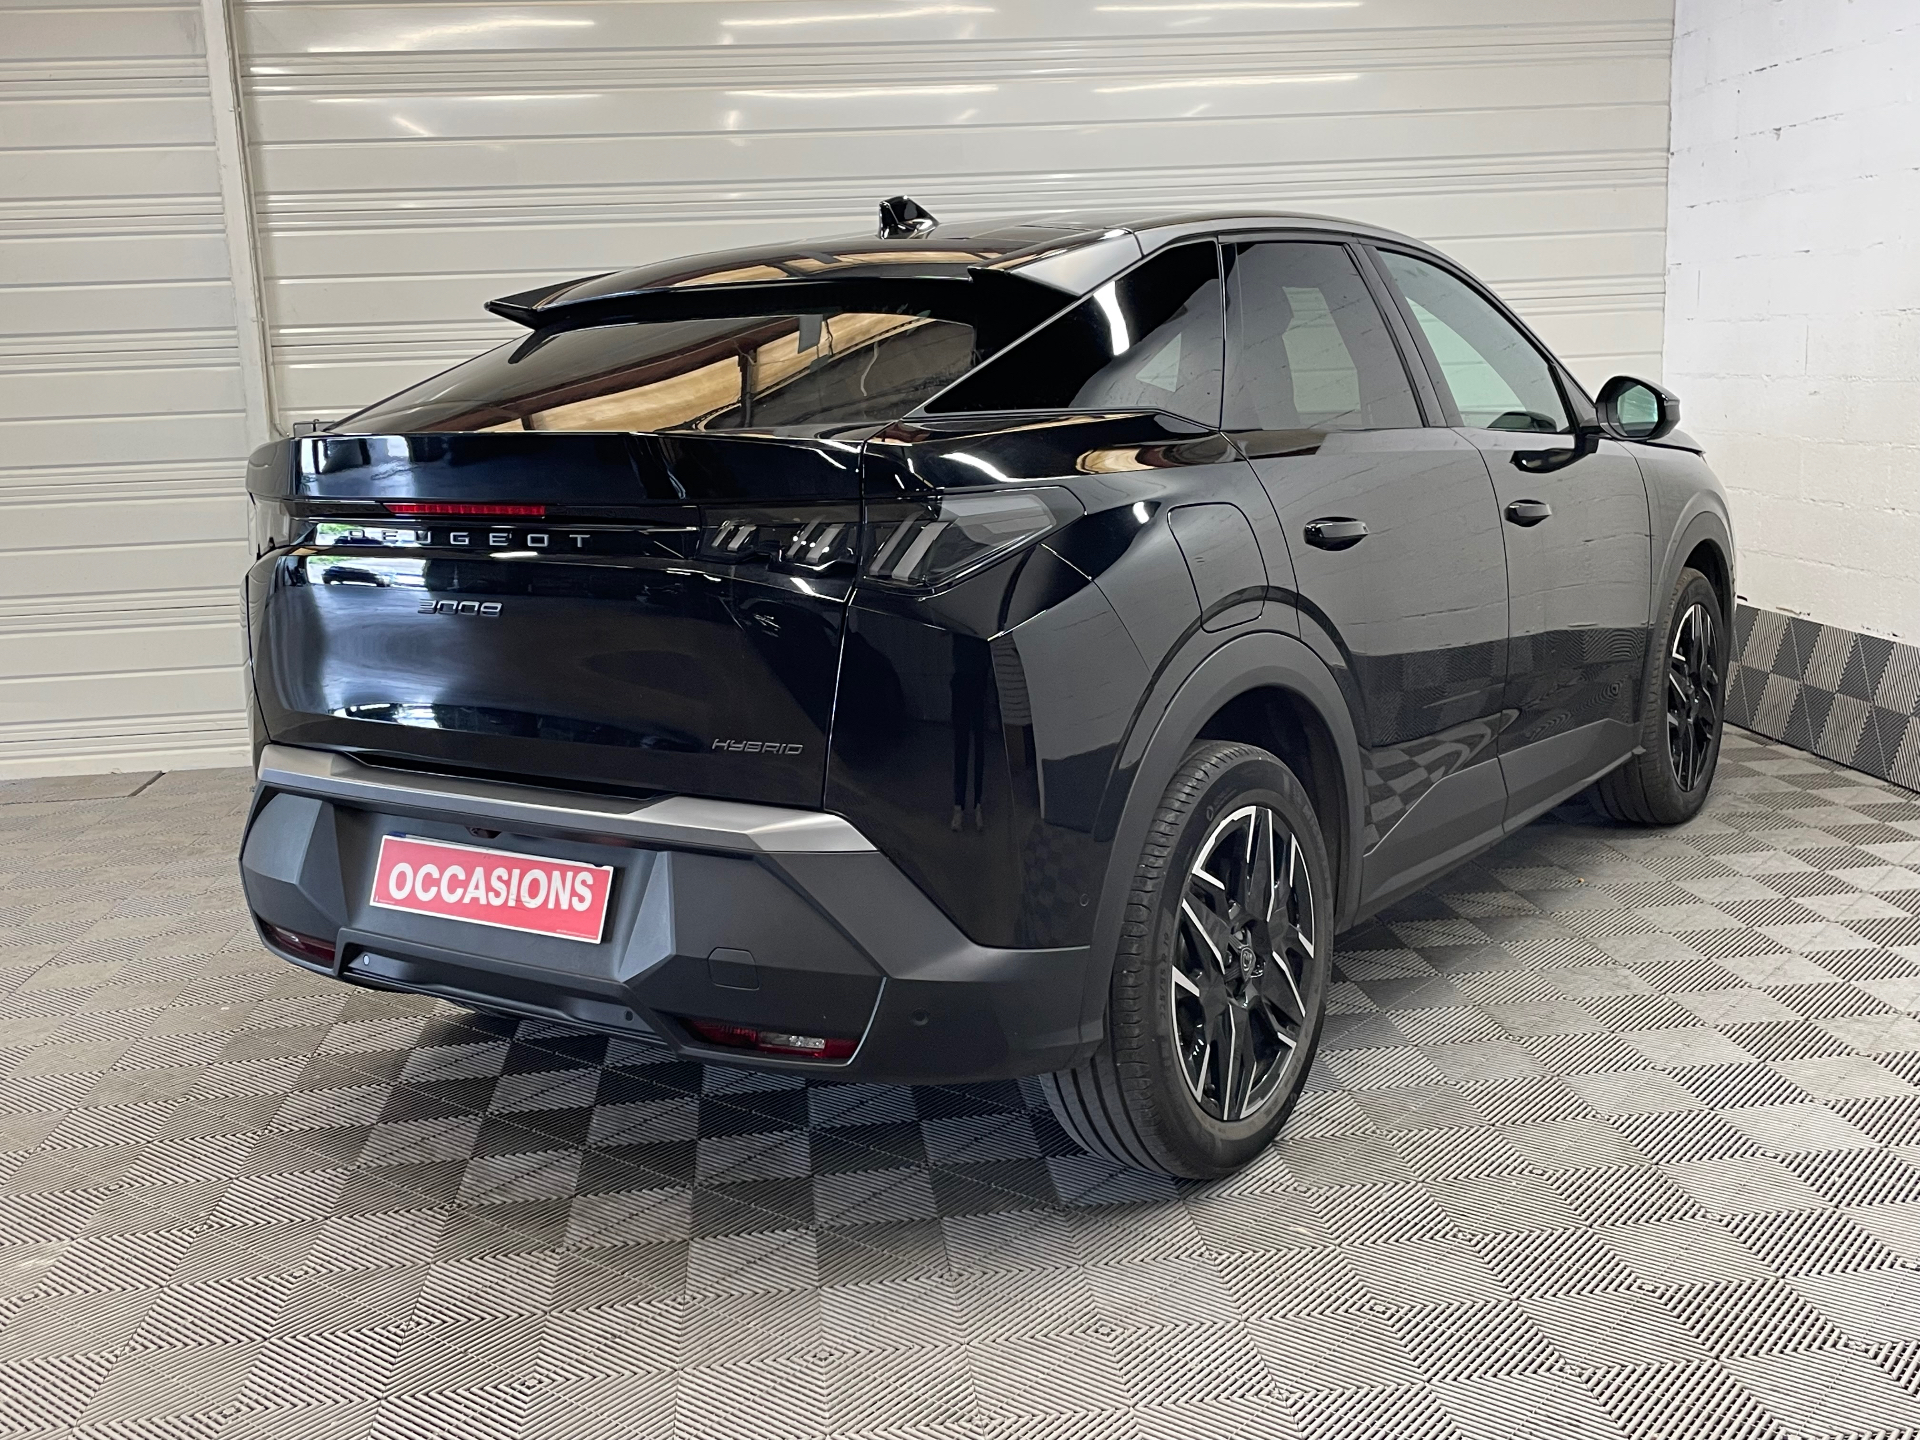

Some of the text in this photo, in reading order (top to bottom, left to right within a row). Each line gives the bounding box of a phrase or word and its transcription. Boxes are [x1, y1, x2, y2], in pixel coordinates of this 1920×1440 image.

[347, 528, 591, 548] PEUGEOT
[418, 599, 503, 618] 3008
[712, 738, 804, 755] HYBRID
[388, 862, 595, 912] OCCASIONS
